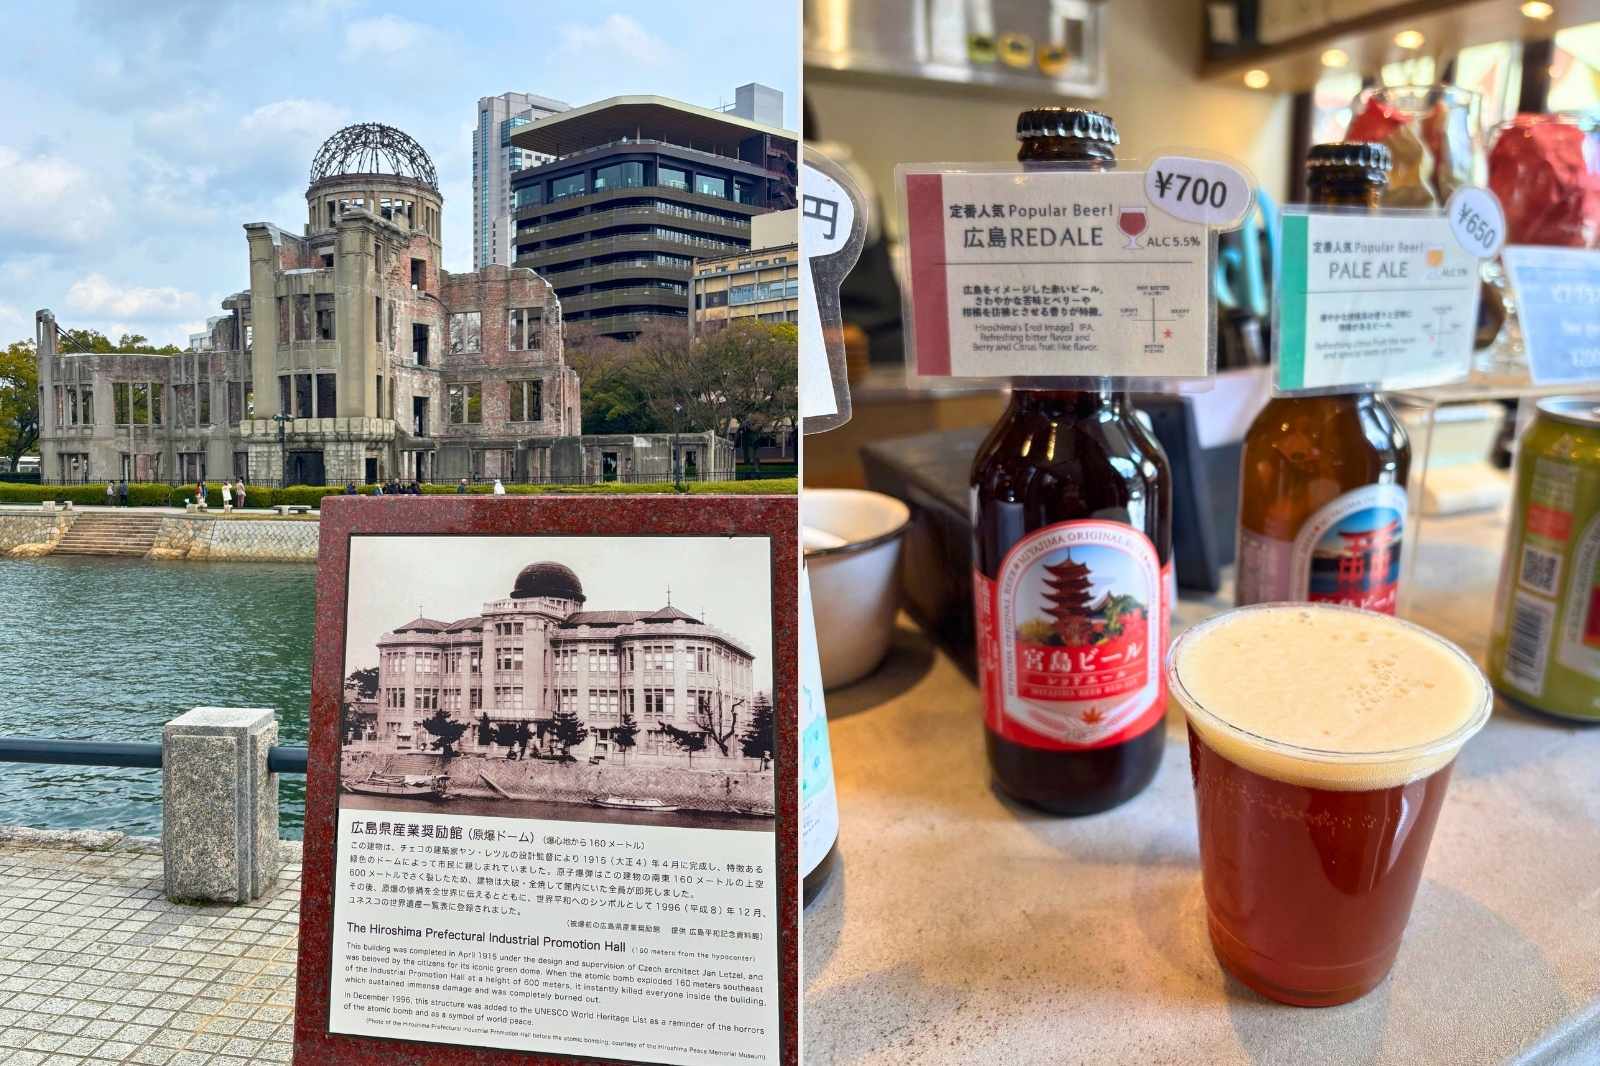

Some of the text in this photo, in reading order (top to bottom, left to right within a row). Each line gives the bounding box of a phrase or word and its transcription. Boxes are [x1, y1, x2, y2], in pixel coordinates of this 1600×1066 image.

[1154, 171, 1227, 208] ¥700
[803, 194, 839, 240] 円
[950, 204, 1113, 220] 定番人気 Popular Beer!
[1457, 203, 1496, 249] ¥650
[1147, 236, 1200, 247] ALC 5.5%
[1329, 262, 1409, 280] PALE ALE
[1024, 643, 1144, 672] 宮島ビール
[350, 820, 463, 840] 広島県産業奨励館
[345, 921, 626, 952] The Hiroshima Prefectural Industrial Promotion Hall
